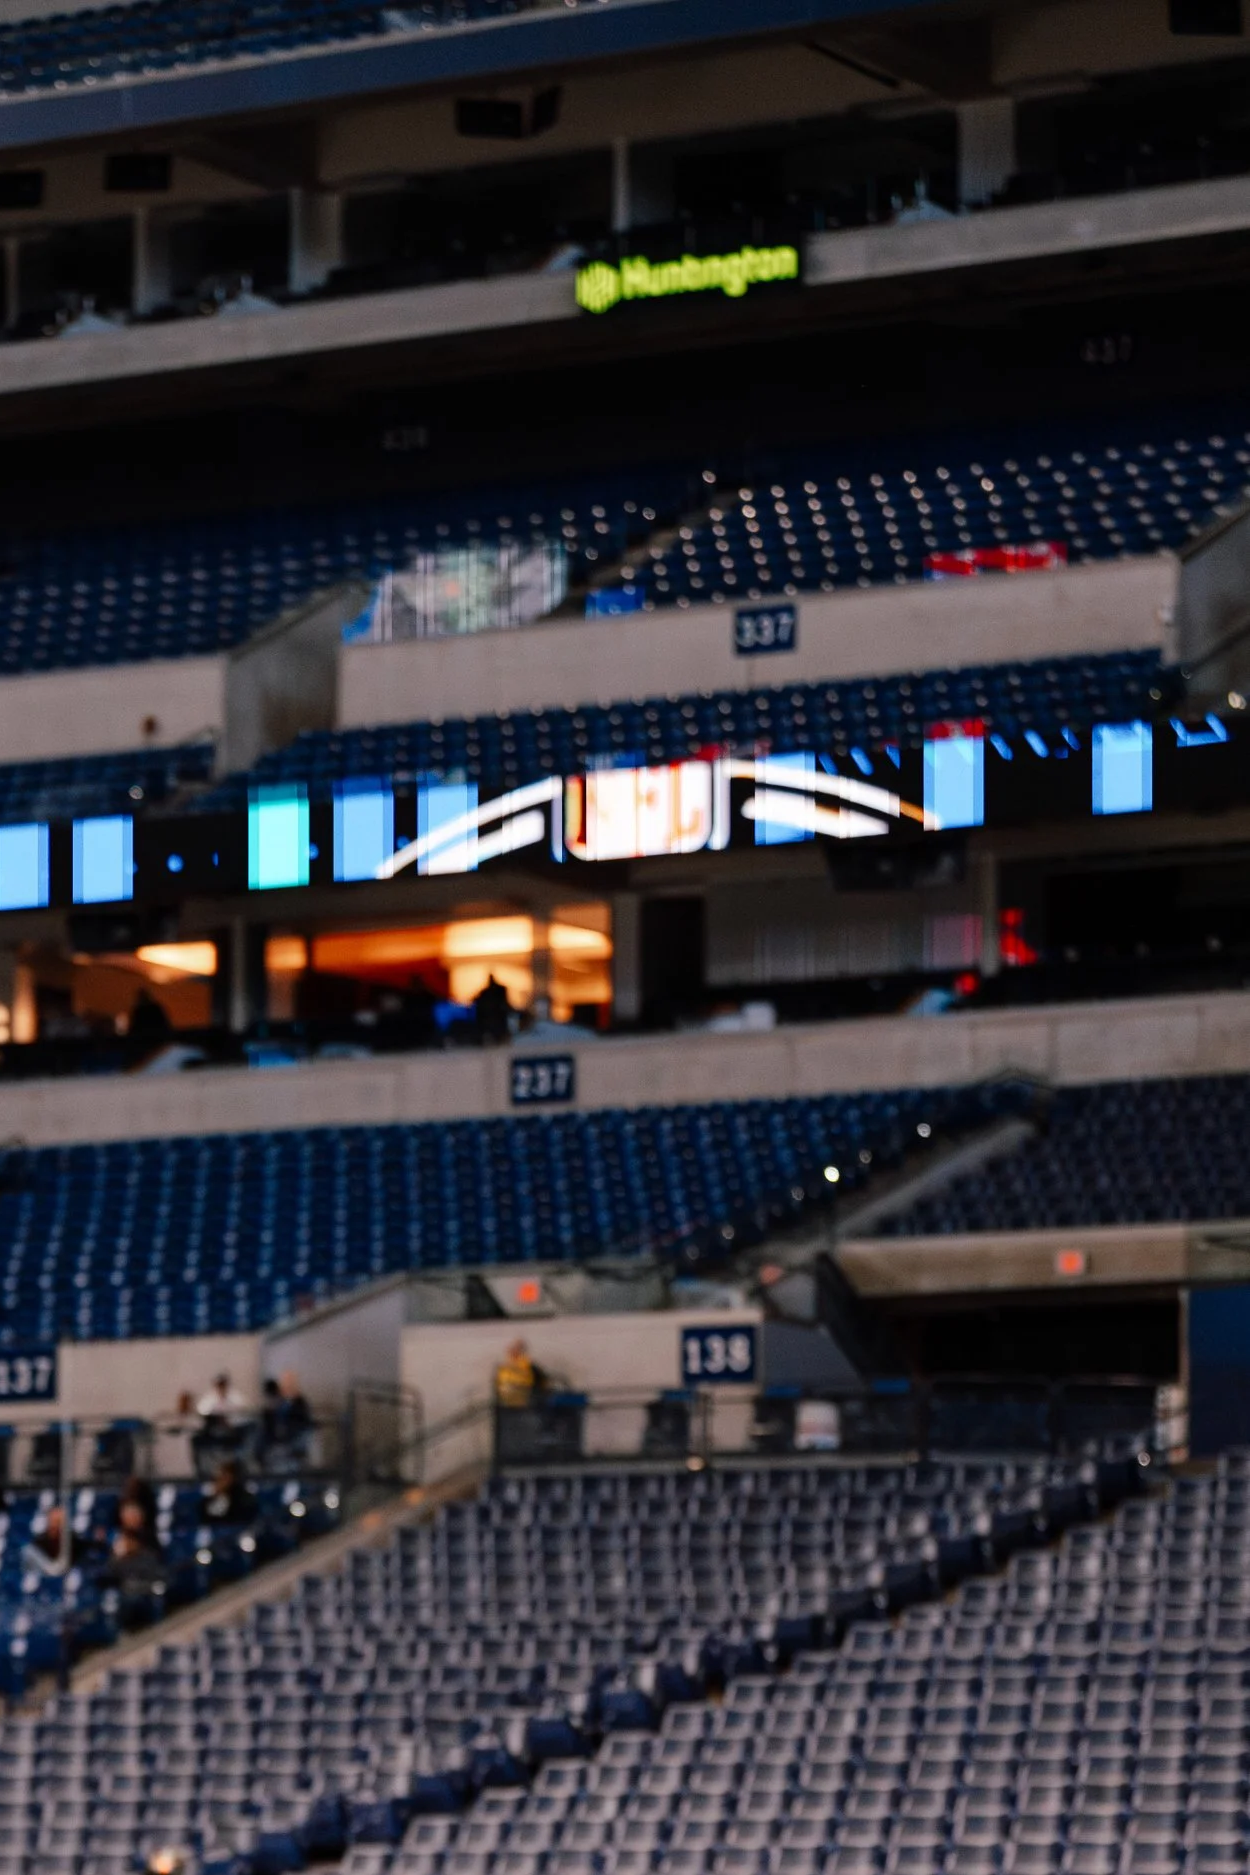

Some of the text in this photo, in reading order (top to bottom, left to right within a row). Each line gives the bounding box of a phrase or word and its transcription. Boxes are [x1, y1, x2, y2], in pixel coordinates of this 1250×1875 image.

[736, 612, 793, 647] 337
[515, 1062, 570, 1097] 237
[686, 1333, 750, 1374] 138
